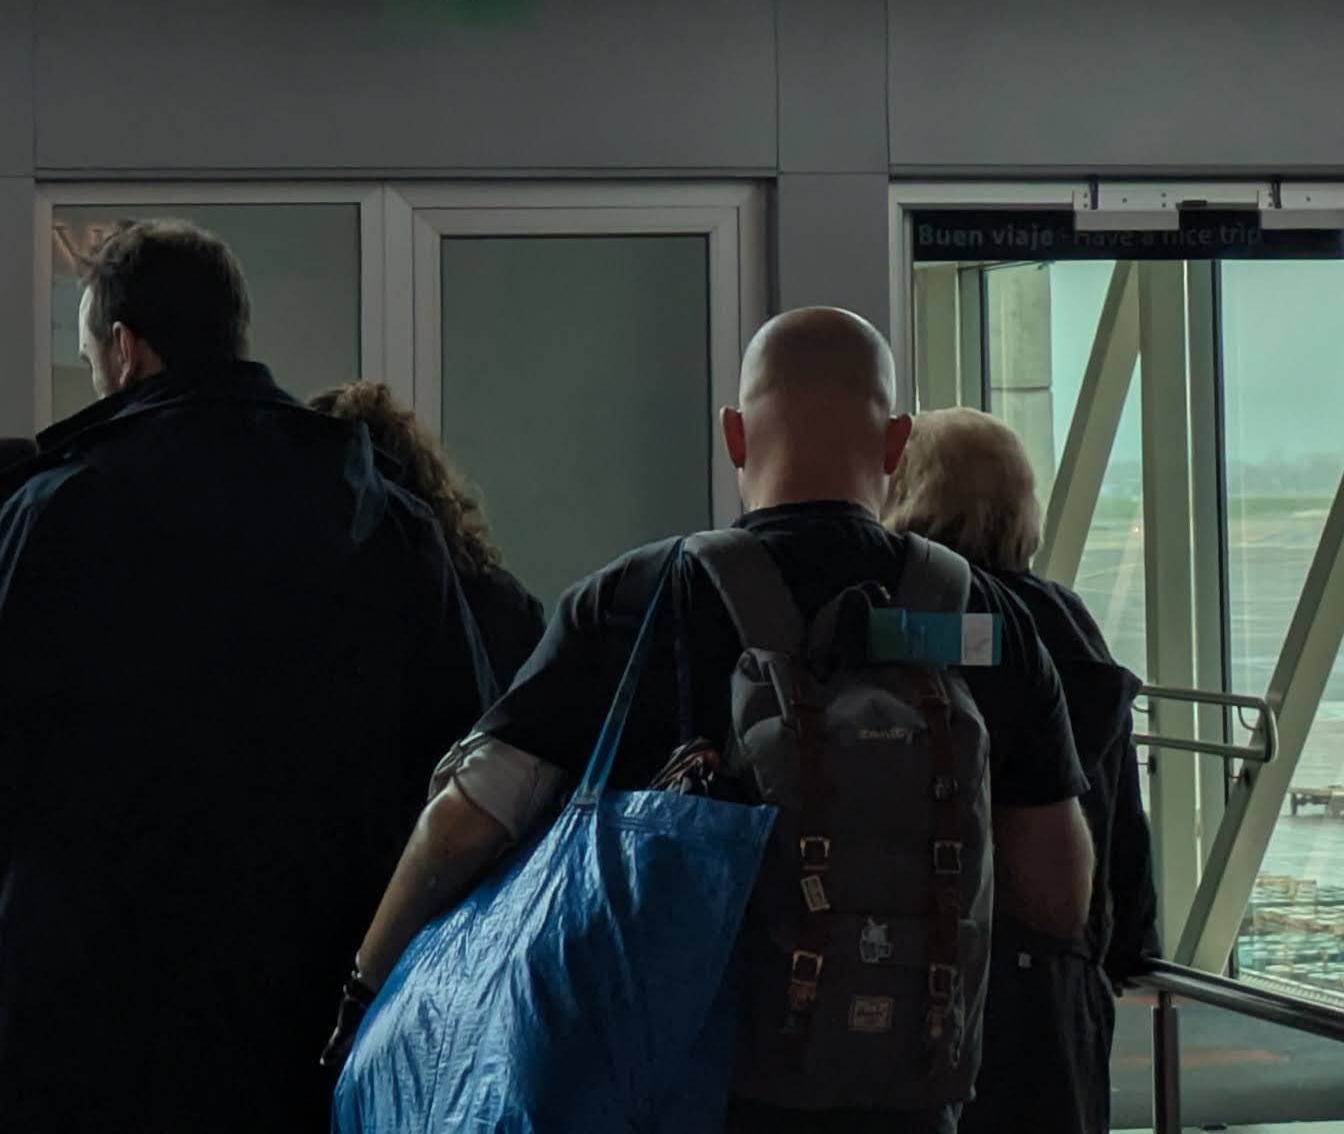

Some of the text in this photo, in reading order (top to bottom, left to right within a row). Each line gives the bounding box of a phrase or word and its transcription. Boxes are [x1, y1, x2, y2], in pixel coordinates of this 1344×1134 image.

[917, 224, 985, 247] Buen
[991, 224, 1054, 251] viaje
[1219, 223, 1264, 250] trip
